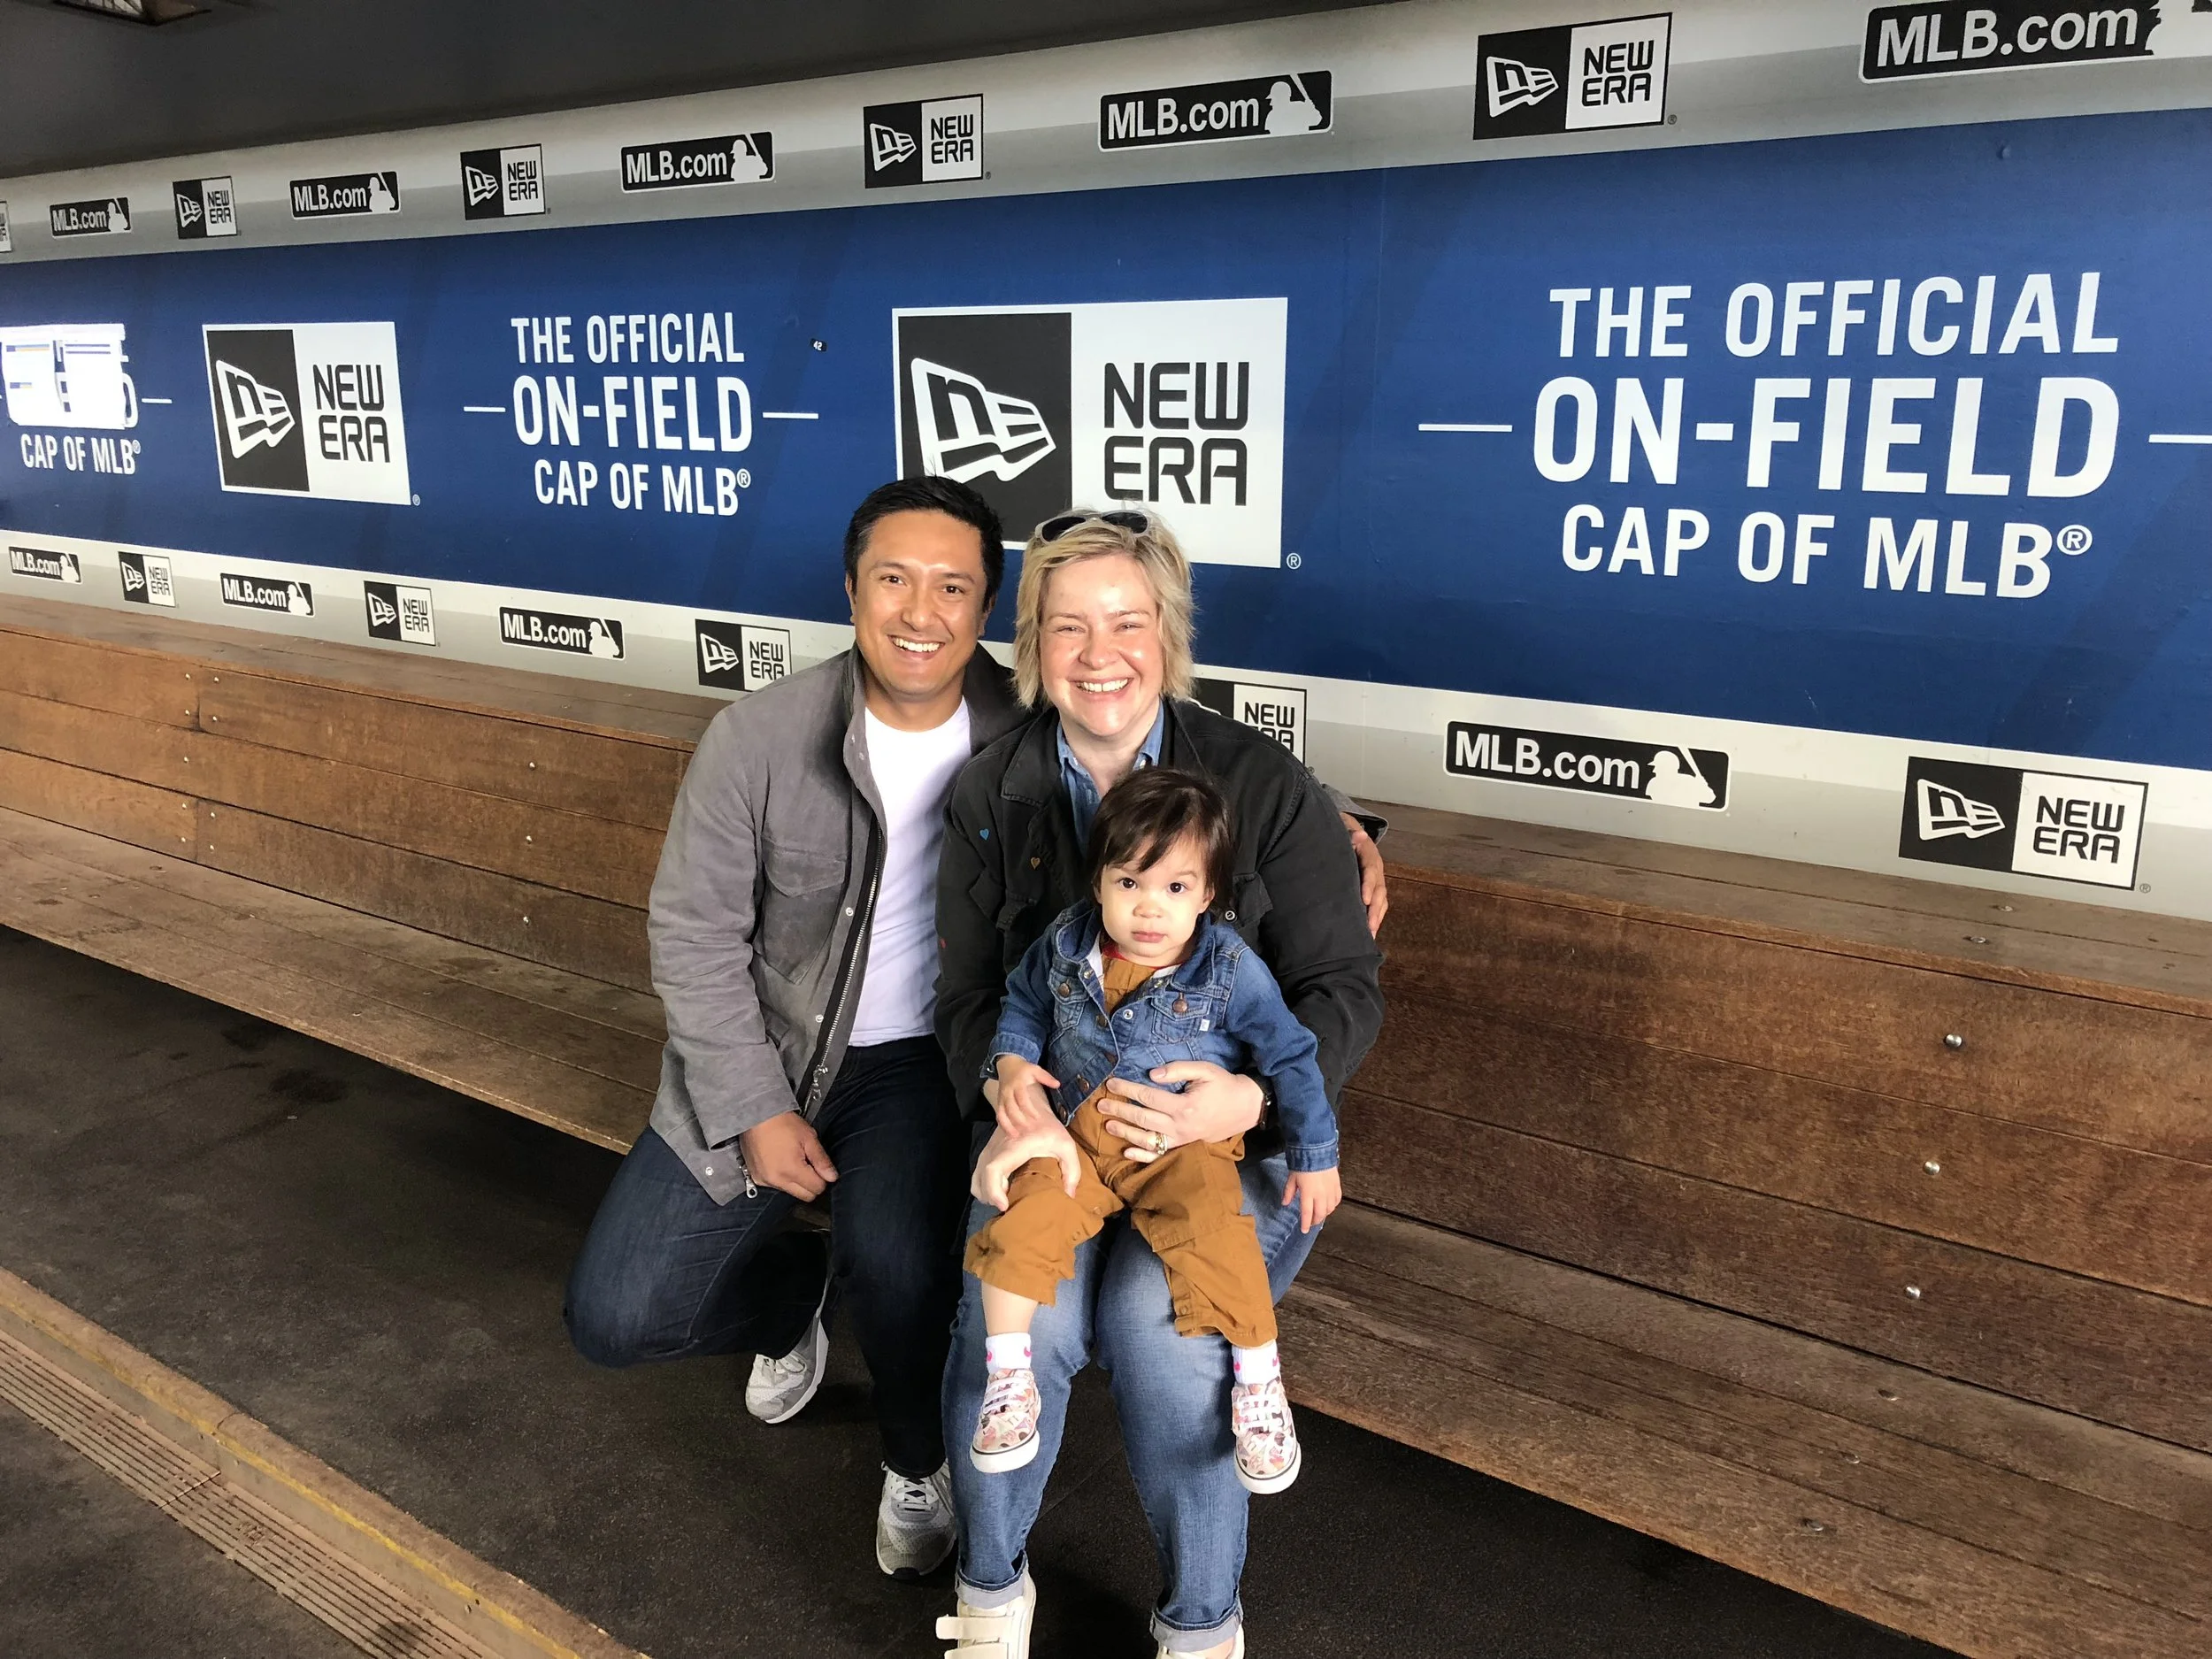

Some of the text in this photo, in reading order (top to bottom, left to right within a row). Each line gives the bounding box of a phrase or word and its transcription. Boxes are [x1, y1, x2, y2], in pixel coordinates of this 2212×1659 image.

[1877, 6, 2139, 67] MLB.com
[1583, 40, 1655, 76] NEW
[1581, 73, 1651, 107] ERA
[930, 114, 974, 141] NEW
[1108, 97, 1259, 141] MLB.com
[626, 151, 728, 184] MLB.com
[931, 140, 974, 165] ERA
[507, 160, 537, 181] NEW
[207, 189, 229, 207] NEW
[293, 185, 367, 212] MLB.com
[509, 180, 539, 202] ERA
[52, 208, 108, 232] MLB.com
[209, 207, 232, 224] ERA
[1548, 272, 2119, 358] THE OFFICIAL
[511, 311, 745, 364] THE OFFICIAL
[813, 341, 823, 351] 42
[312, 365, 385, 411] NEW
[1103, 361, 1249, 431] NEW
[513, 375, 752, 452] ON-FIELD
[20, 434, 58, 469] CAP
[63, 435, 87, 472] OF
[319, 414, 390, 463] ERA
[1532, 375, 2120, 498] ON-FIELD
[534, 458, 598, 506] CAP
[610, 462, 649, 511] OF
[1103, 435, 1248, 506] ERA
[1561, 503, 1709, 577] CAP
[1737, 510, 1836, 585] OF
[11, 550, 60, 576] MLB.com
[149, 565, 168, 582] NEW
[150, 581, 171, 596] ERA
[223, 578, 287, 608] MLB.com
[402, 597, 428, 616] NEW
[404, 615, 430, 633] ERA
[503, 612, 587, 649] MLB.com
[749, 641, 783, 662] NEW
[751, 660, 784, 680] ERA
[1244, 702, 1295, 728] NEW
[1455, 730, 1640, 789] MLB.com
[2036, 795, 2125, 833] NEW
[2032, 826, 2121, 864] ERA
